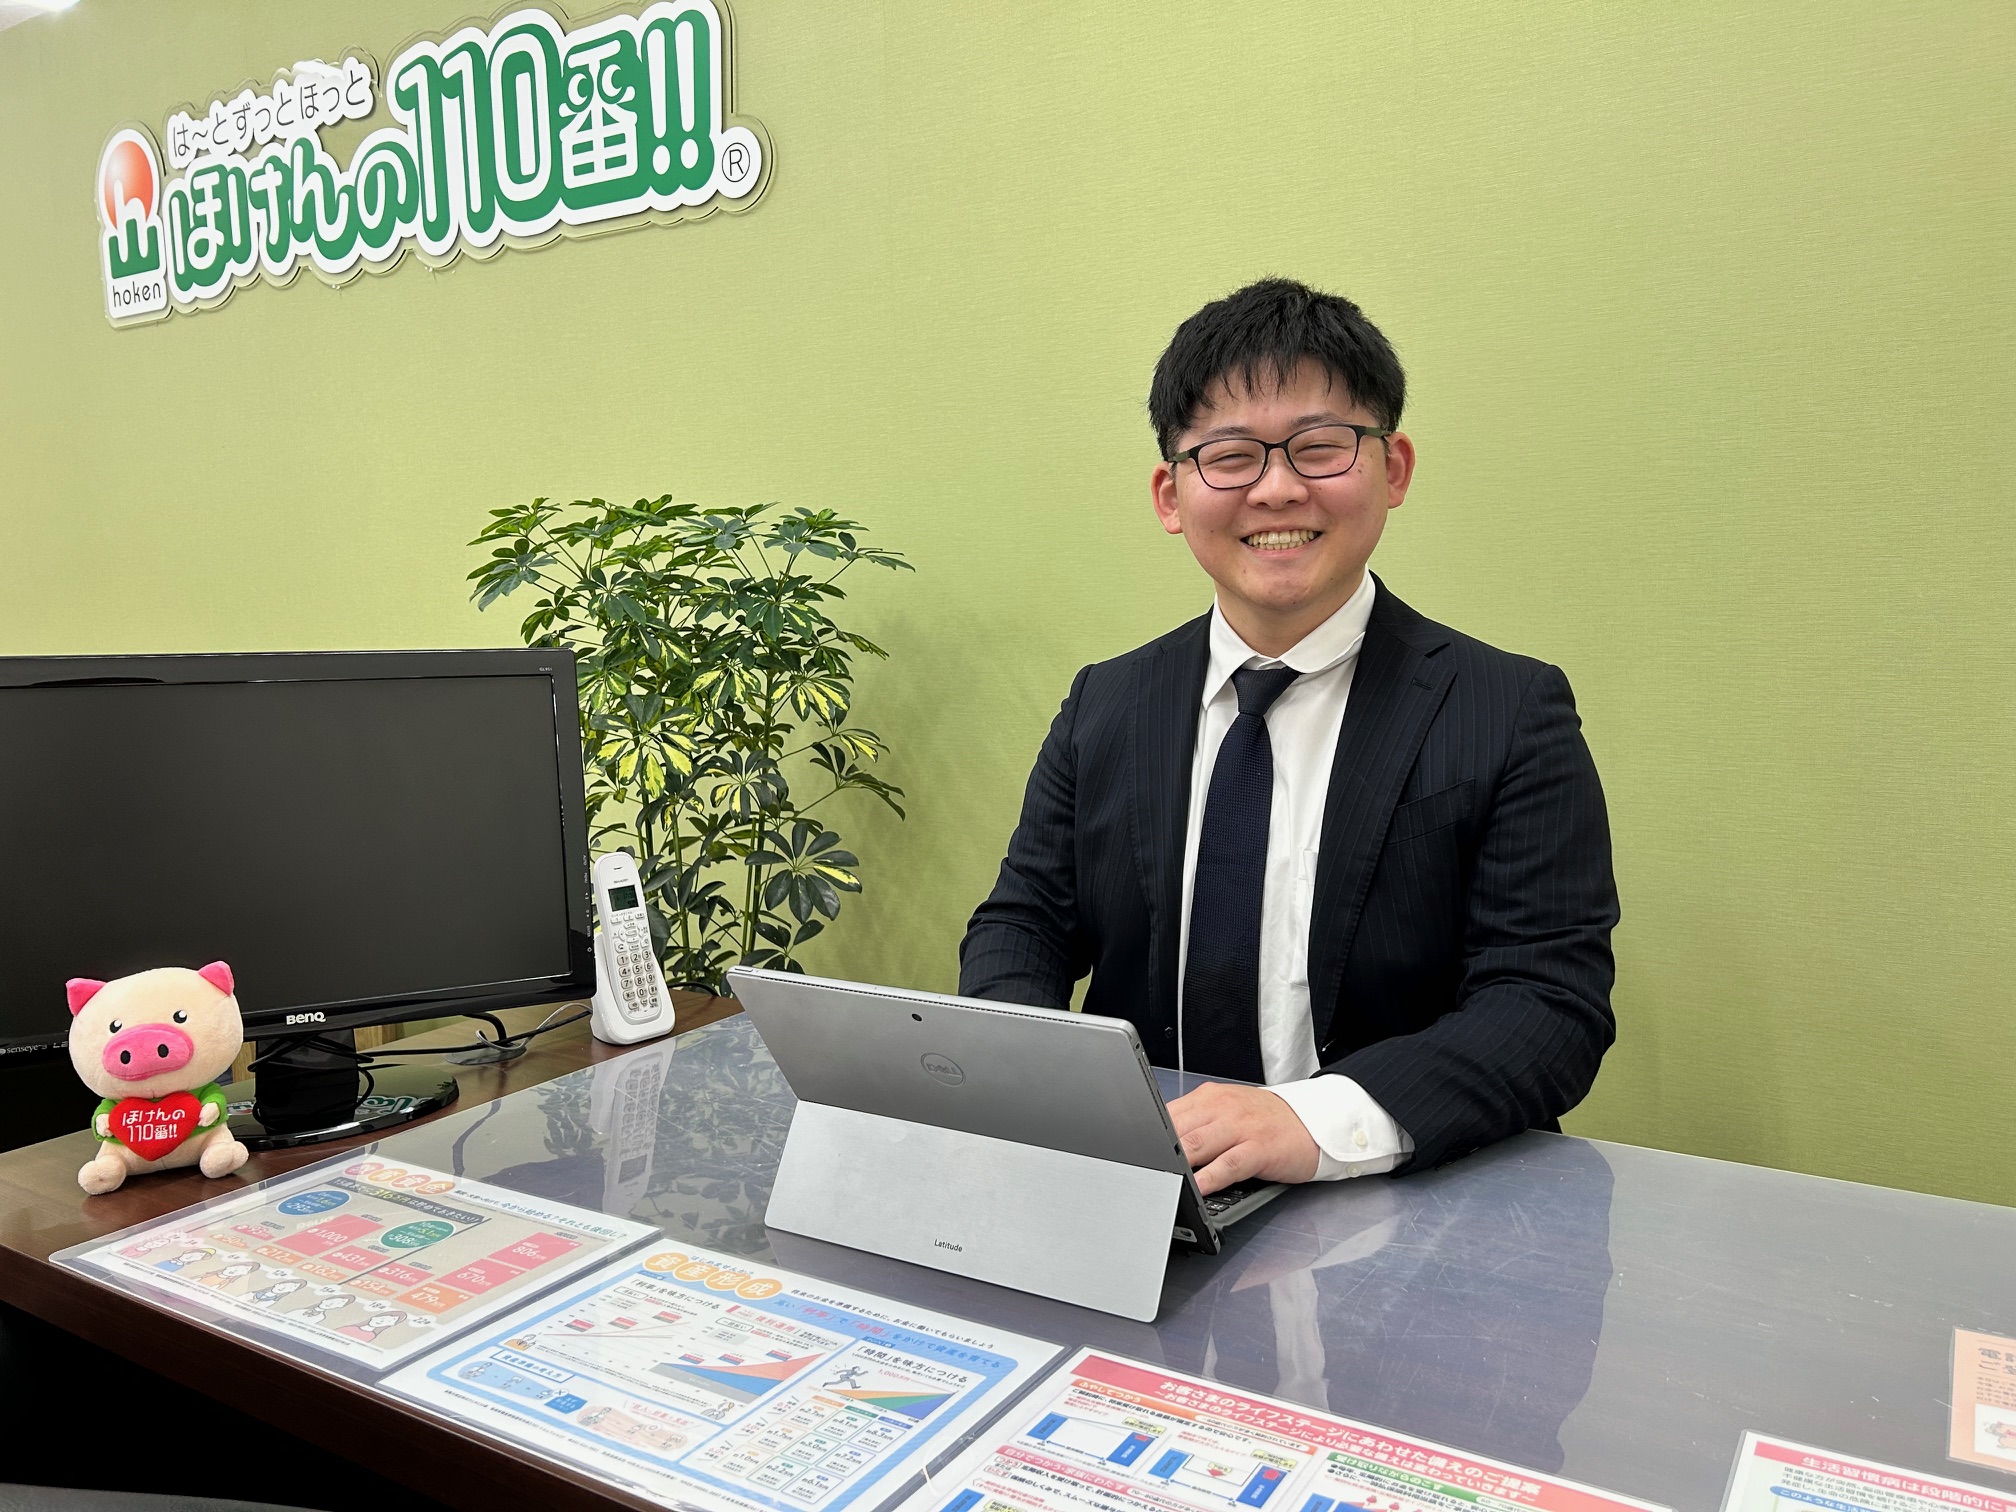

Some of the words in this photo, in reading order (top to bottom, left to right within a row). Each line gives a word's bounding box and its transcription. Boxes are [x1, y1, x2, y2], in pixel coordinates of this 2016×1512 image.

[112, 281, 162, 308] hoken
[286, 1011, 327, 1025] BenQ
[122, 1107, 186, 1126] ほけんの
[127, 1123, 178, 1142] 110番!!
[934, 1238, 963, 1252] Latitude
[654, 1254, 772, 1297] 資産形成
[857, 1345, 968, 1383] 「時間」を味方につける
[1079, 1381, 1142, 1403] ふやしてつかう
[1160, 1381, 1542, 1496] お客さまのライフステージにあわせた備えのご提案
[1004, 1448, 1125, 1490] 自分でつかう・家族にわたす
[1335, 1453, 1443, 1491] 受け取りながらのこす
